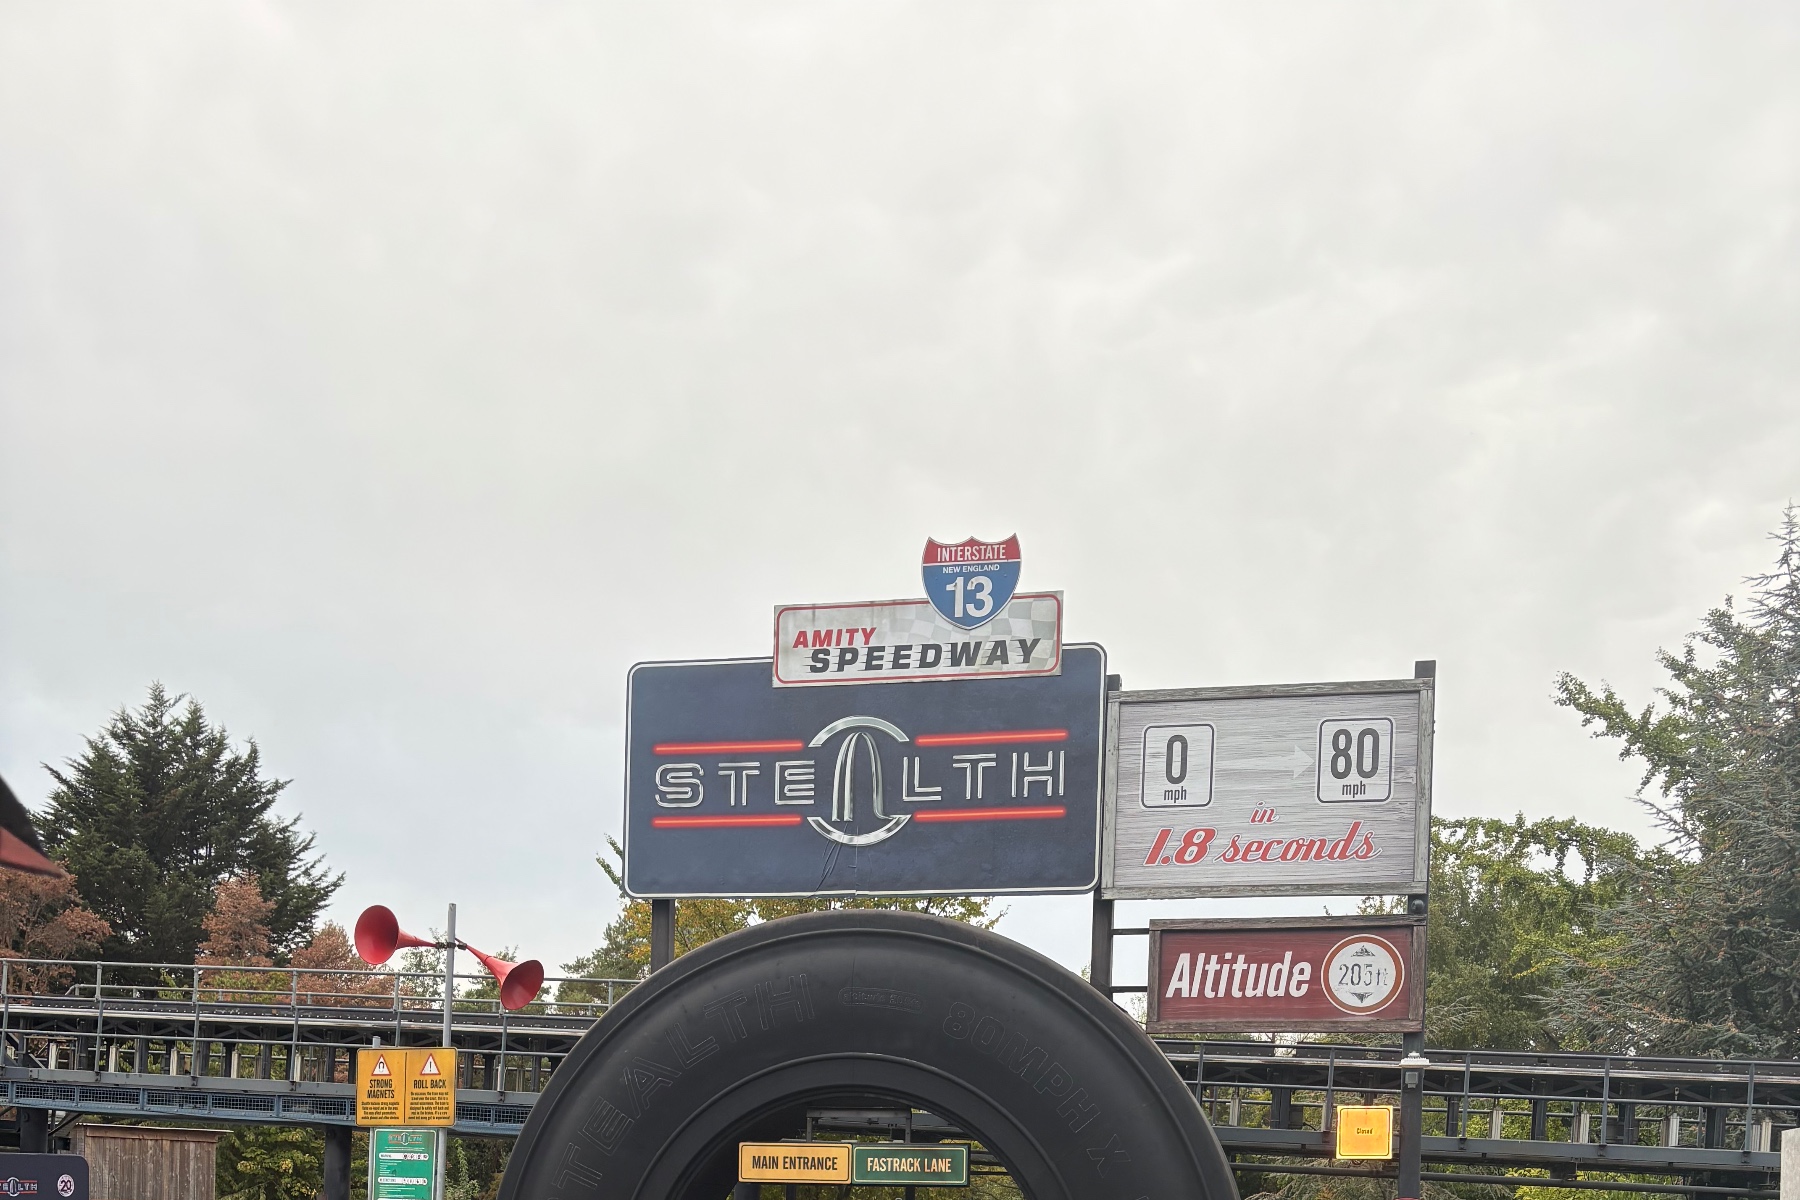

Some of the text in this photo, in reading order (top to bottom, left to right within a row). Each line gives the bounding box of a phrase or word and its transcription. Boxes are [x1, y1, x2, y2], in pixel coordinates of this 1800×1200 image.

[937, 544, 1006, 562] INTERSTATE
[942, 564, 1000, 574] NEW ENGLAND
[946, 575, 994, 618] 13
[793, 627, 877, 648] AMITY
[806, 638, 1040, 673] SPEEDWAY
[1166, 734, 1188, 785] 0
[1331, 727, 1380, 780] 80
[1164, 786, 1187, 803] mph
[1342, 781, 1366, 798] mph
[1250, 801, 1279, 824] in
[1144, 820, 1382, 866] 1.8 seconds
[1165, 951, 1312, 998] Altitude
[369, 1079, 393, 1089] STRONG
[413, 1079, 447, 1089] ROLL BACK
[367, 1089, 395, 1099] MAGNETS
[752, 1155, 838, 1171] MAIN ENTRANCE
[867, 1157, 952, 1173] FASTRACK LANE
